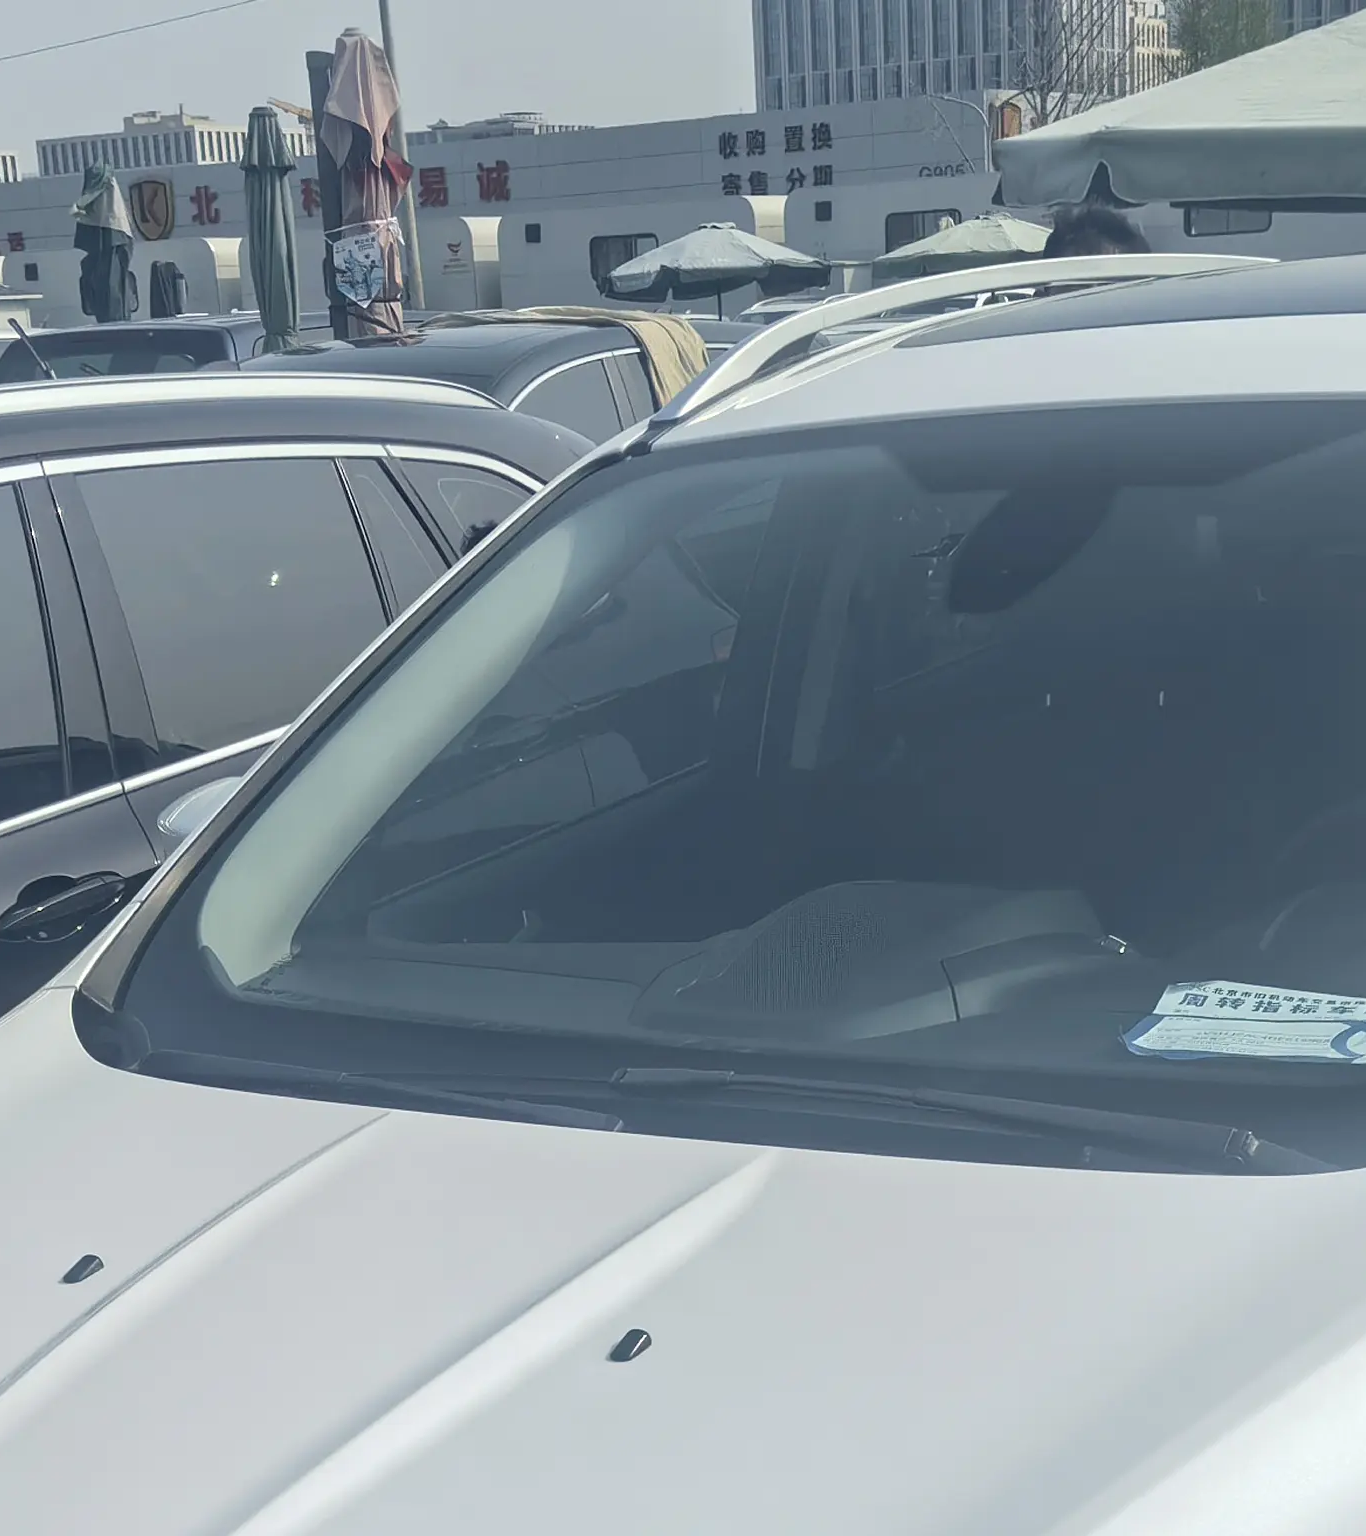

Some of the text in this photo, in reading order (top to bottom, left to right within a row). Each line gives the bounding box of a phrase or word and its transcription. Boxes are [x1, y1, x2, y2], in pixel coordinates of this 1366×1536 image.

[719, 122, 833, 159] 收购 置换
[721, 171, 768, 196] 寄售
